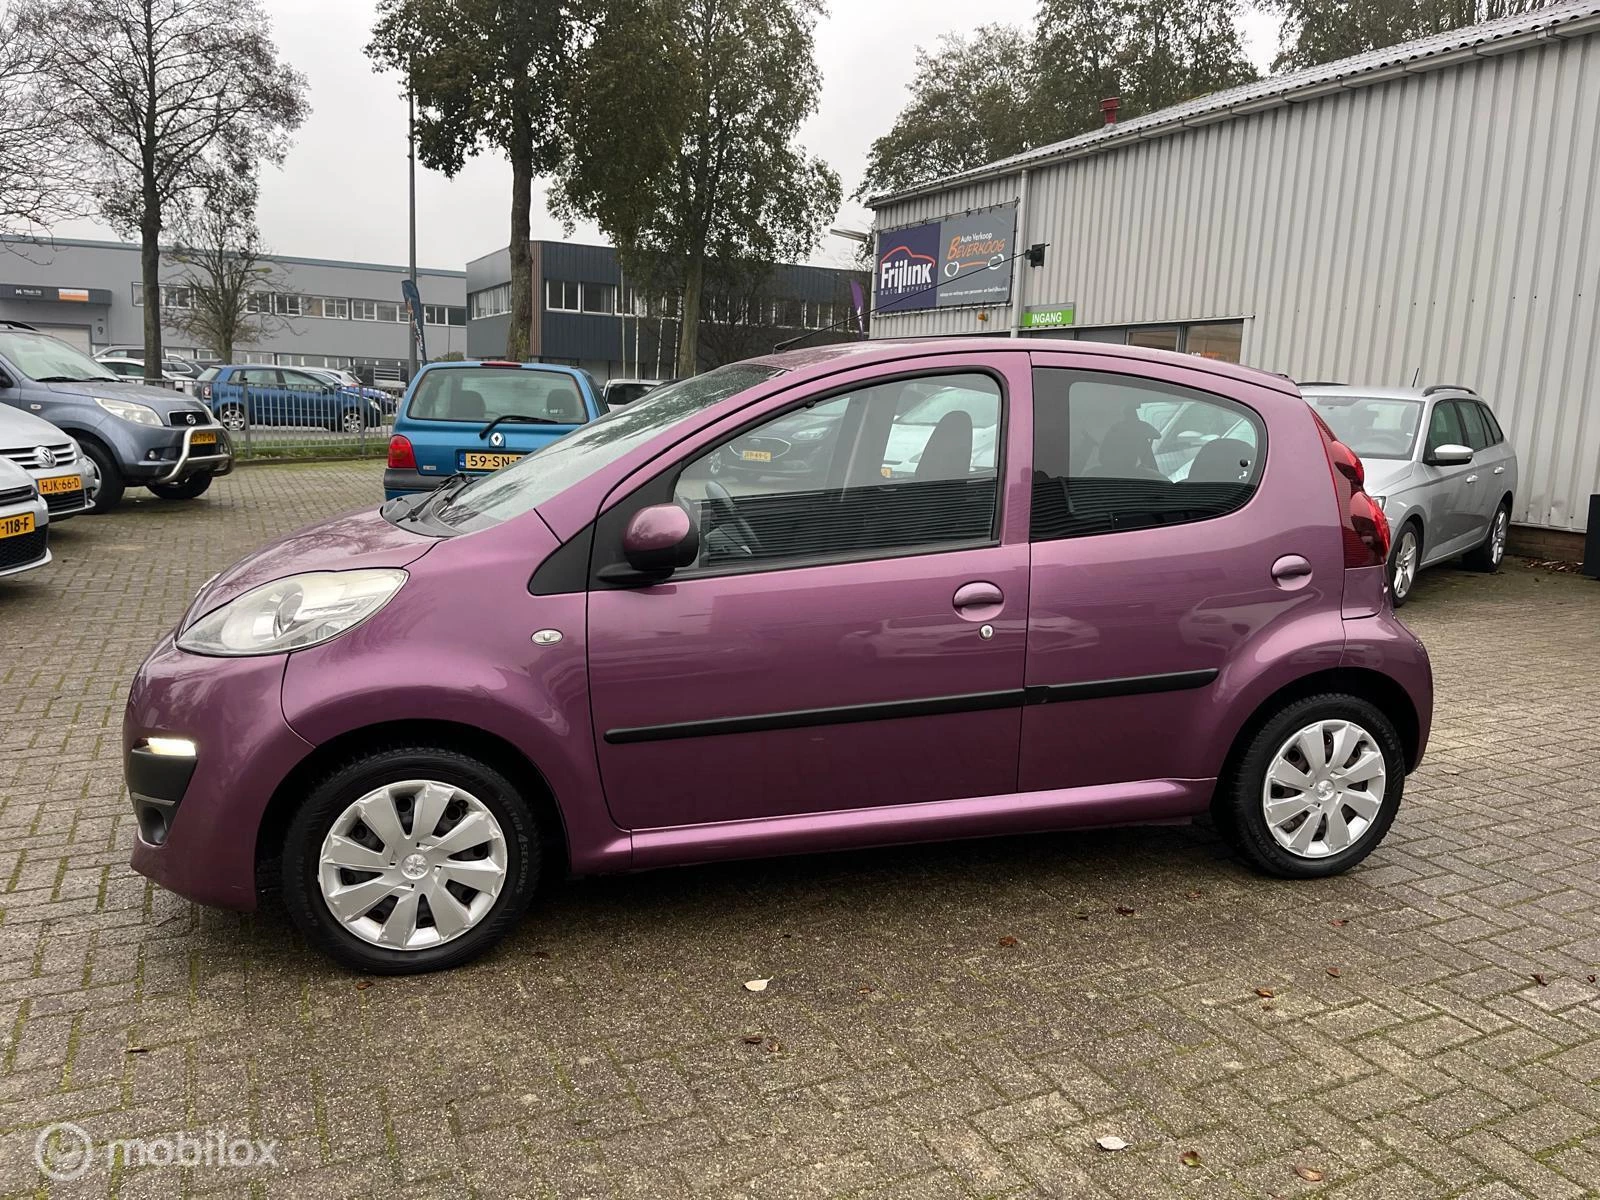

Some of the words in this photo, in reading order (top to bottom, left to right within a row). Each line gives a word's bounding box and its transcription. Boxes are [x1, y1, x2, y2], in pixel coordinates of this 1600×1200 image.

[960, 235, 972, 243] Auto
[973, 231, 993, 241] Verkoop
[947, 235, 1006, 260] BEVERKOOG
[880, 288, 897, 296] auto
[902, 284, 932, 293] service
[1031, 311, 1063, 324] INGANG
[41, 477, 80, 493] HJK-66-D
